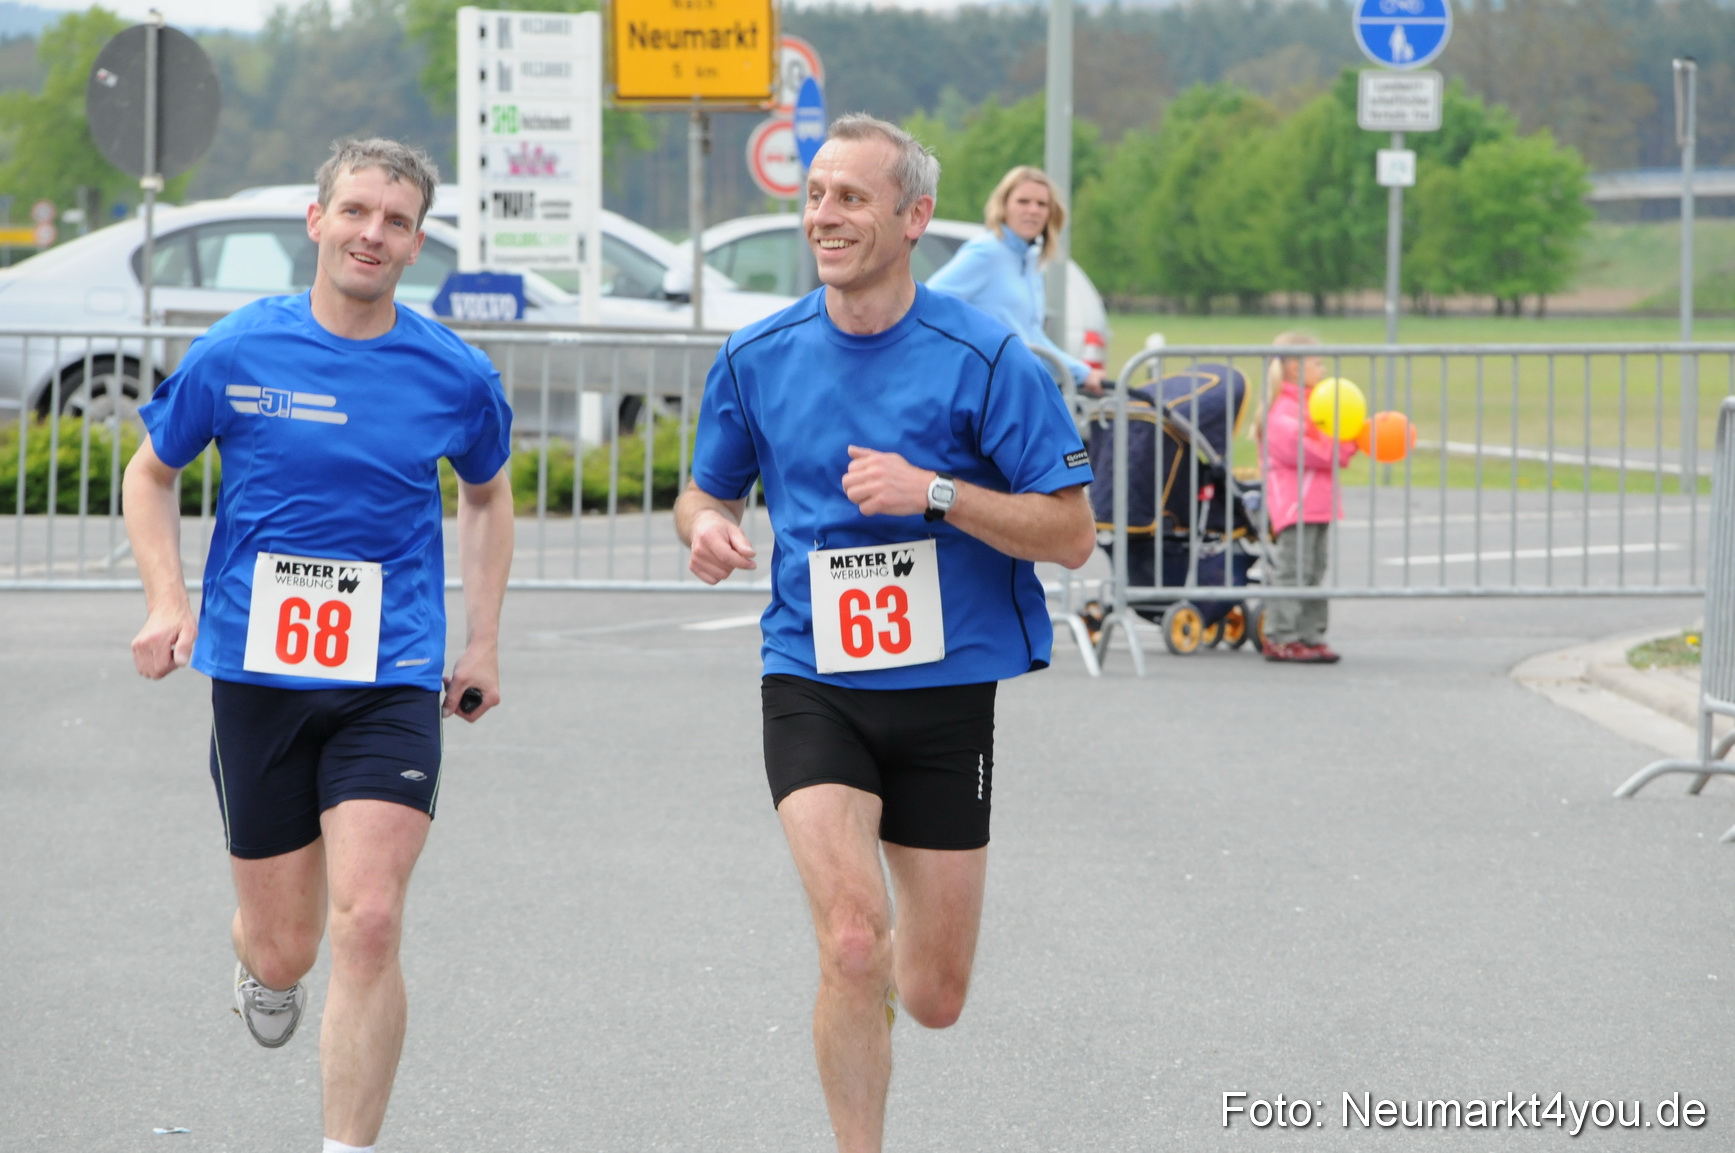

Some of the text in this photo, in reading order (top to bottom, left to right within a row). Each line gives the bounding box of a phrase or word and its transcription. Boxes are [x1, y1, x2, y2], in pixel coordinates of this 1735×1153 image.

[628, 21, 757, 49] Neumarkt
[695, 63, 718, 78] km
[449, 292, 518, 320] VOLVO
[829, 552, 887, 569] MEYER
[275, 561, 334, 578] MEYER
[830, 567, 890, 580] WERBUNG
[275, 575, 335, 590] WERBUNG
[838, 585, 912, 659] 63
[275, 597, 352, 667] 68
